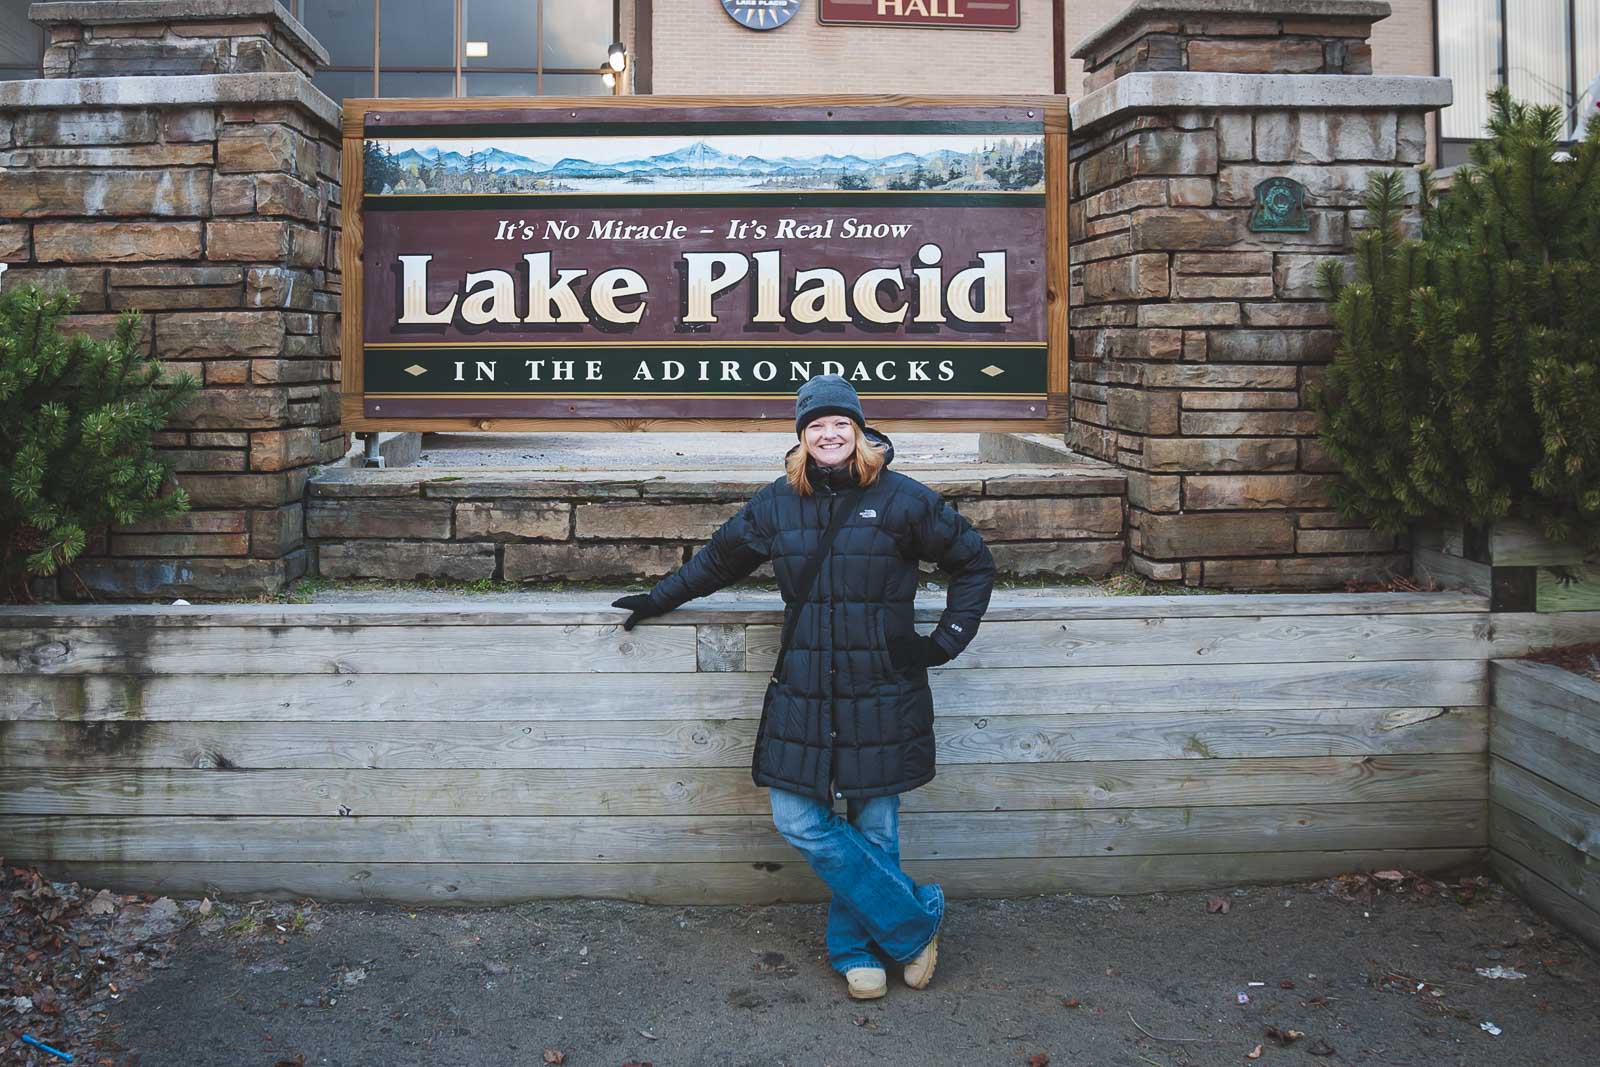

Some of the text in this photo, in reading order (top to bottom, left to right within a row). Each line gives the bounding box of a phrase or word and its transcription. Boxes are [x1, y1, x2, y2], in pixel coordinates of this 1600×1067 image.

[877, 0, 965, 17] HALL
[494, 219, 535, 241] It's
[542, 220, 580, 241] No
[587, 219, 688, 240] Miracle
[726, 219, 768, 240] It's
[774, 218, 834, 240] Real
[840, 217, 913, 240] Snow
[397, 243, 1014, 325] Lake Placid
[453, 359, 956, 382] IN THE ADIRONDACKS
